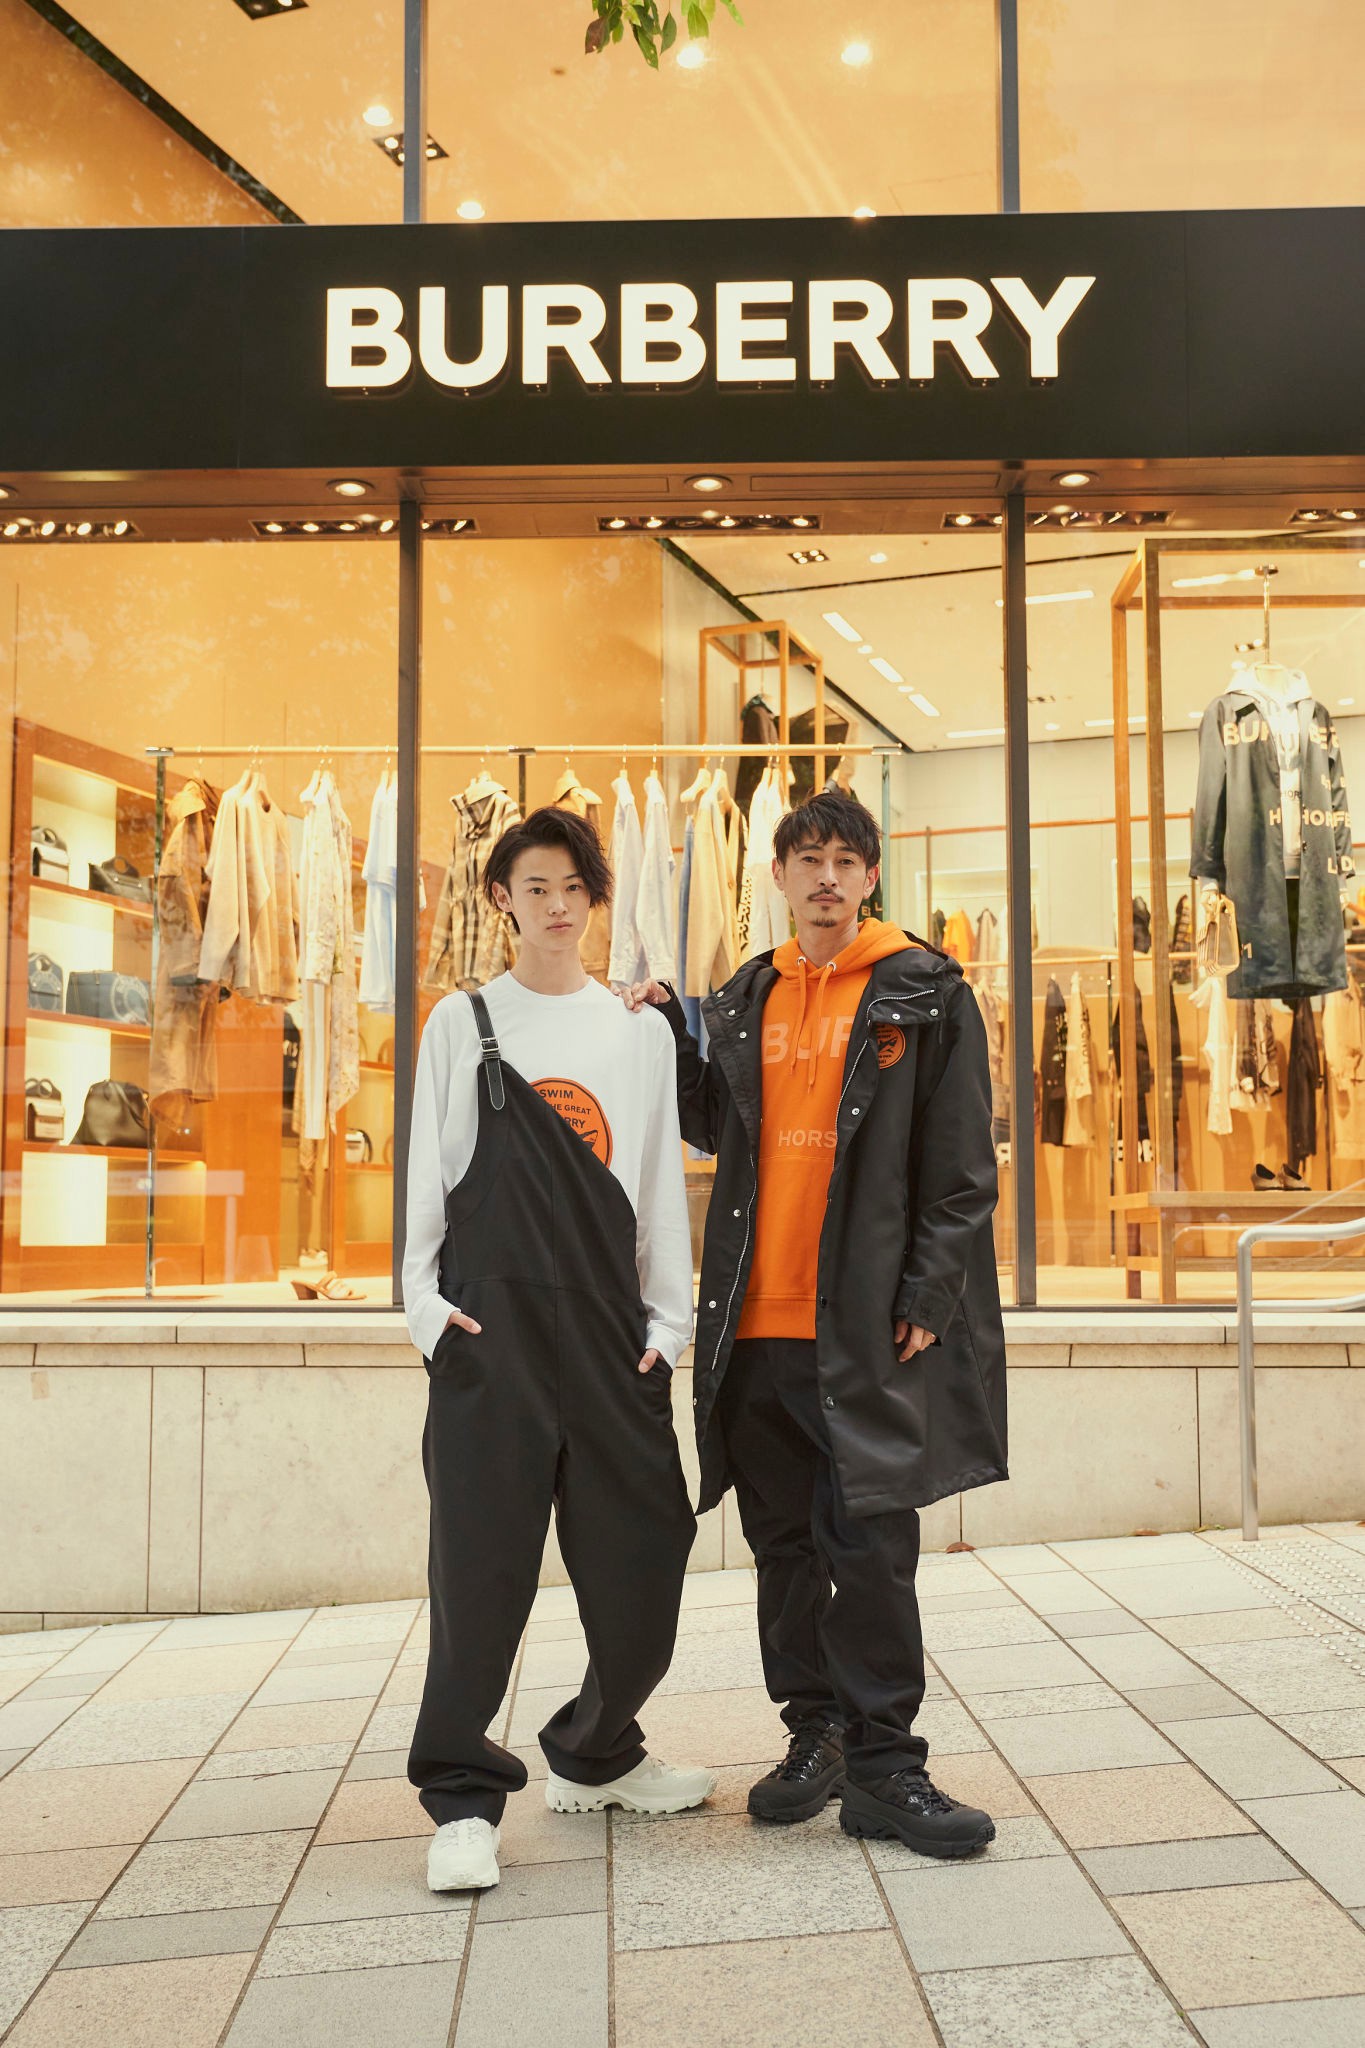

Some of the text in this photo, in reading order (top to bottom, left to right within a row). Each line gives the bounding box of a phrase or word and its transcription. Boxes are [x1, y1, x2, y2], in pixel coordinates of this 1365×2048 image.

[326, 276, 1096, 388] BURBERRY
[539, 1089, 574, 1099] SWIM
[564, 1104, 592, 1115] GREAT
[778, 1129, 837, 1149] HORS
